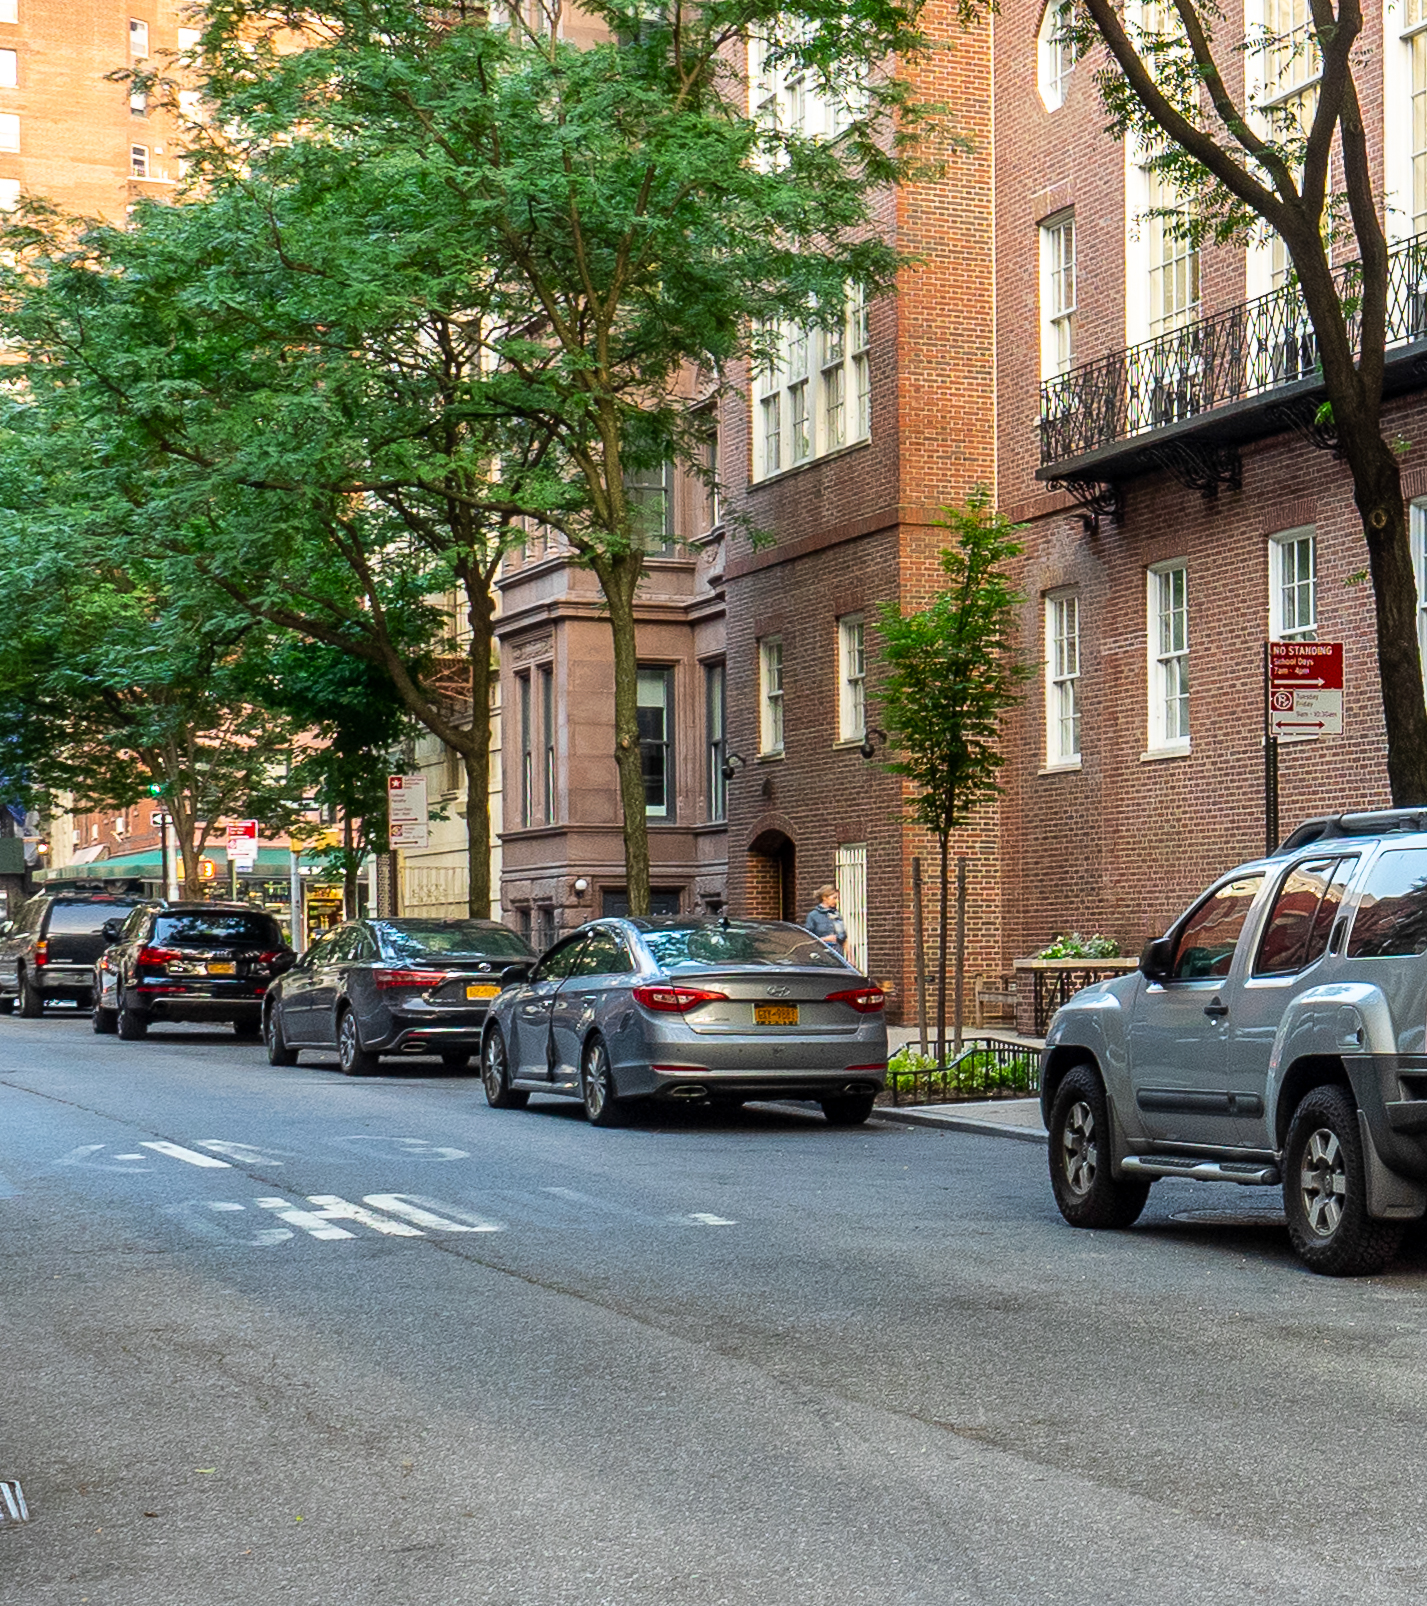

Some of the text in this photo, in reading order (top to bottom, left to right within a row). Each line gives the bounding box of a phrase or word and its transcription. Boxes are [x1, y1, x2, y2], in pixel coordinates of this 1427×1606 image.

[1273, 645, 1333, 656] NO STANDING
[1273, 657, 1314, 667] School Days
